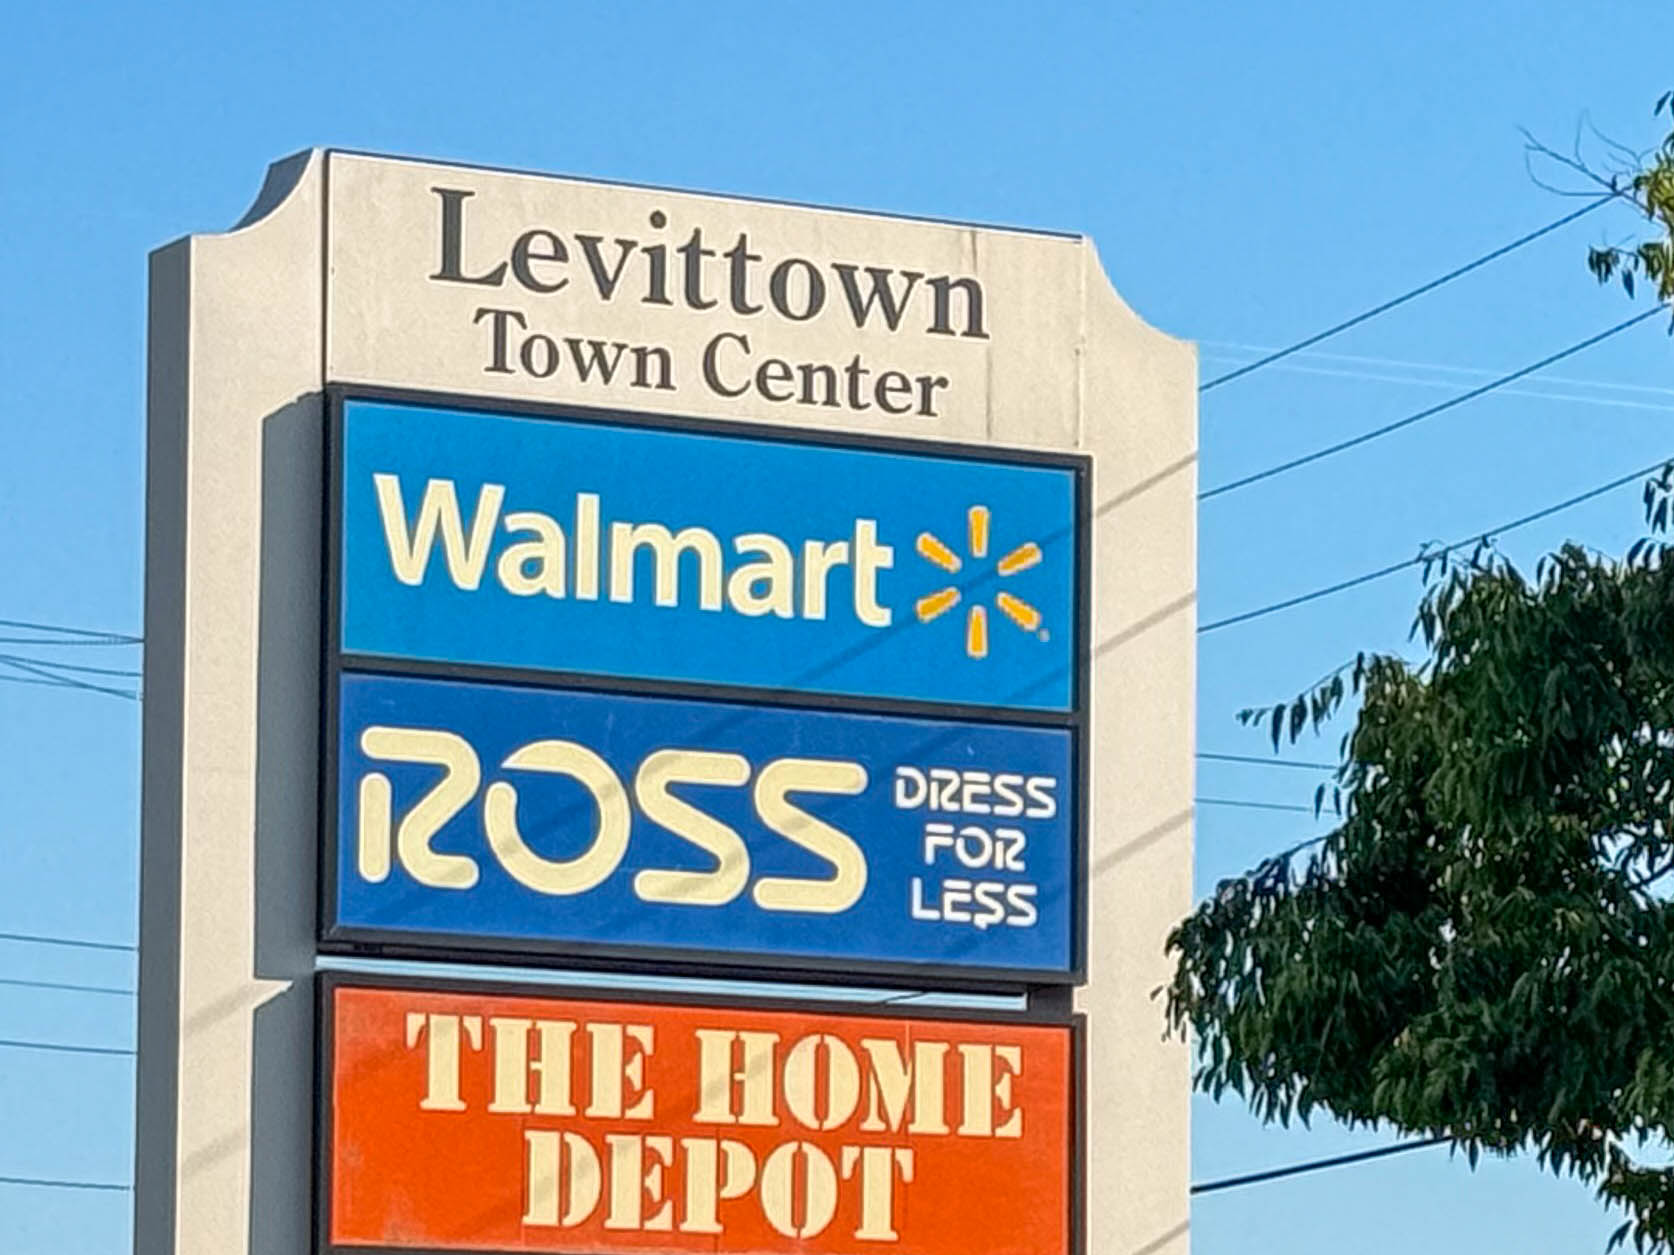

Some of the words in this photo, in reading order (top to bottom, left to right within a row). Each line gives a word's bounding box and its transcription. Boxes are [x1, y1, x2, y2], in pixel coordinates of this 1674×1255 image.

[430, 186, 990, 340] Levittown
[474, 306, 676, 391] Town
[702, 332, 949, 417] Center
[372, 472, 893, 627] Walmart
[358, 725, 869, 915] ROSS
[895, 766, 1057, 820] DRESS
[924, 823, 1026, 873] FOR
[911, 876, 1038, 930] LESS
[405, 1011, 655, 1120] THE
[693, 1027, 1024, 1138] HOME
[522, 1129, 915, 1242] DEPOT
